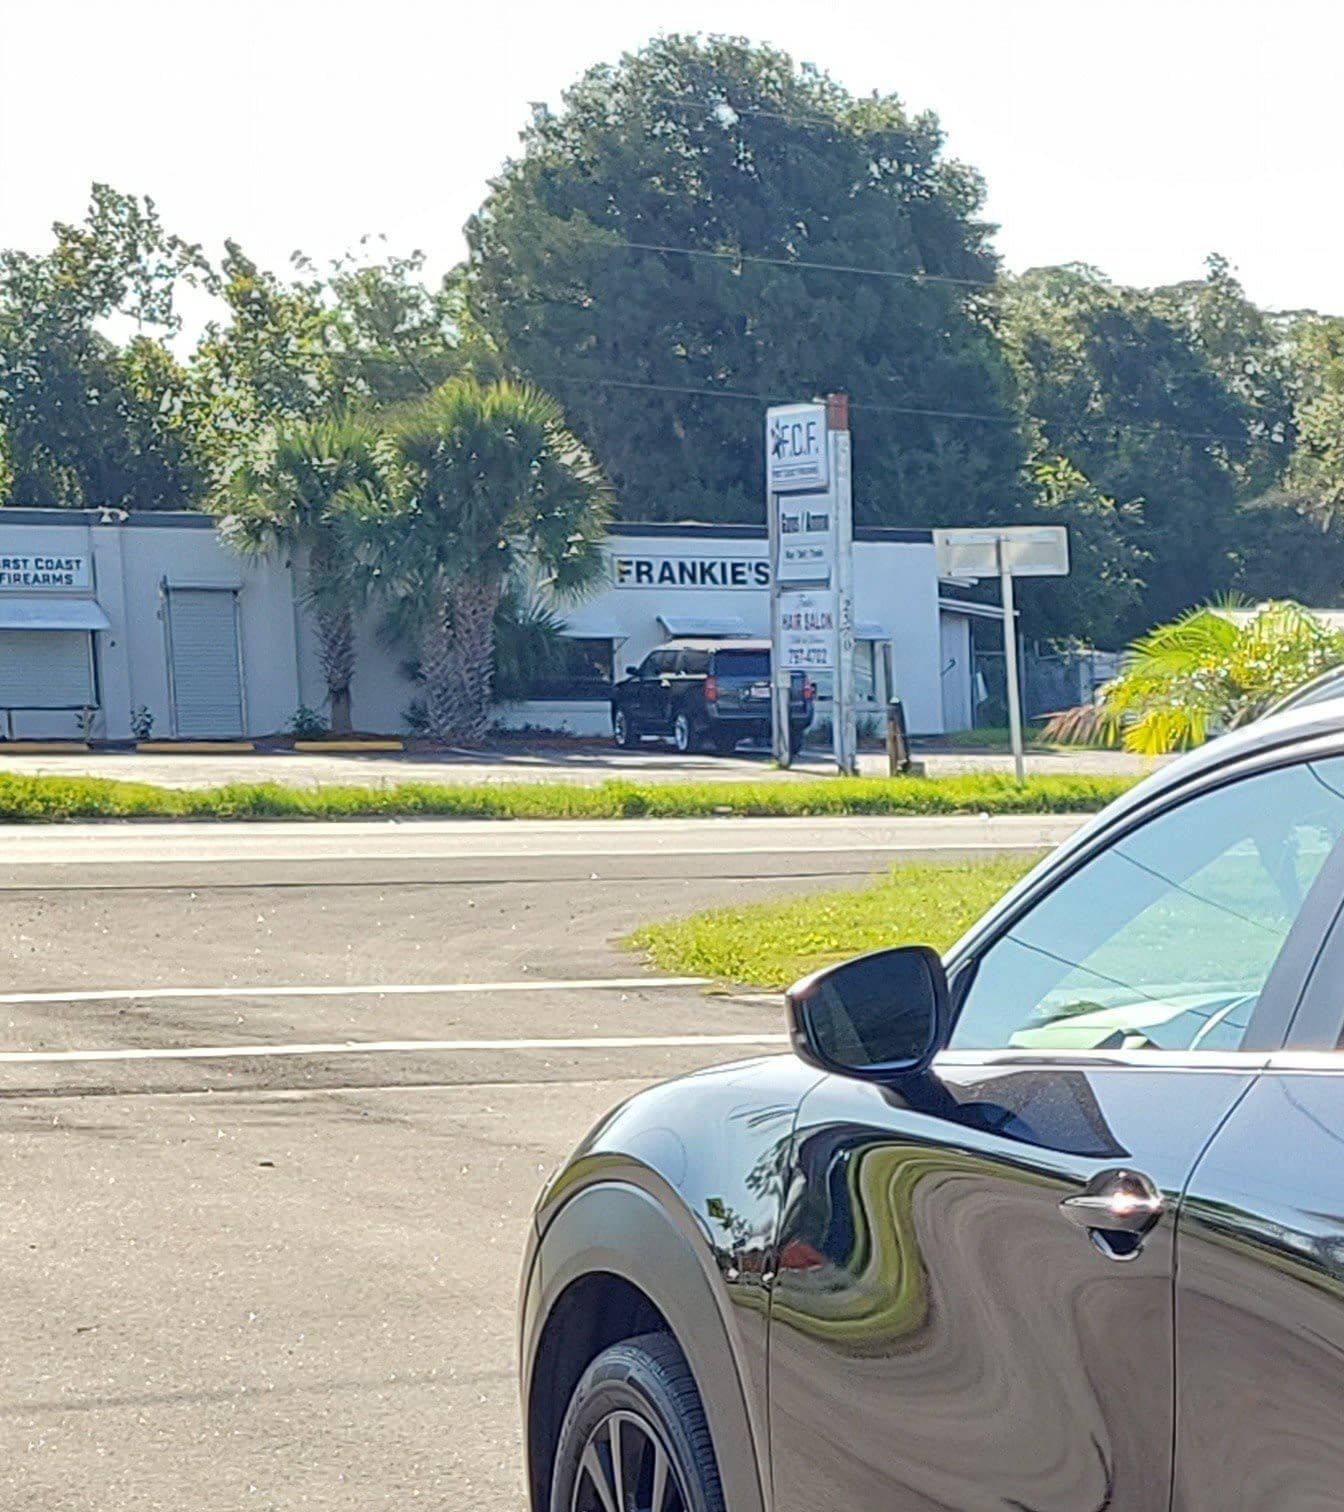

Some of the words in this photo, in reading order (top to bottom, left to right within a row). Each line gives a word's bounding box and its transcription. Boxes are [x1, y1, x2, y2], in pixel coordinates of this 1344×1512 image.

[0, 558, 28, 570] RST
[34, 557, 82, 571] COAST
[0, 572, 74, 585] FIREARMS
[617, 559, 771, 586] FRANKIE'S
